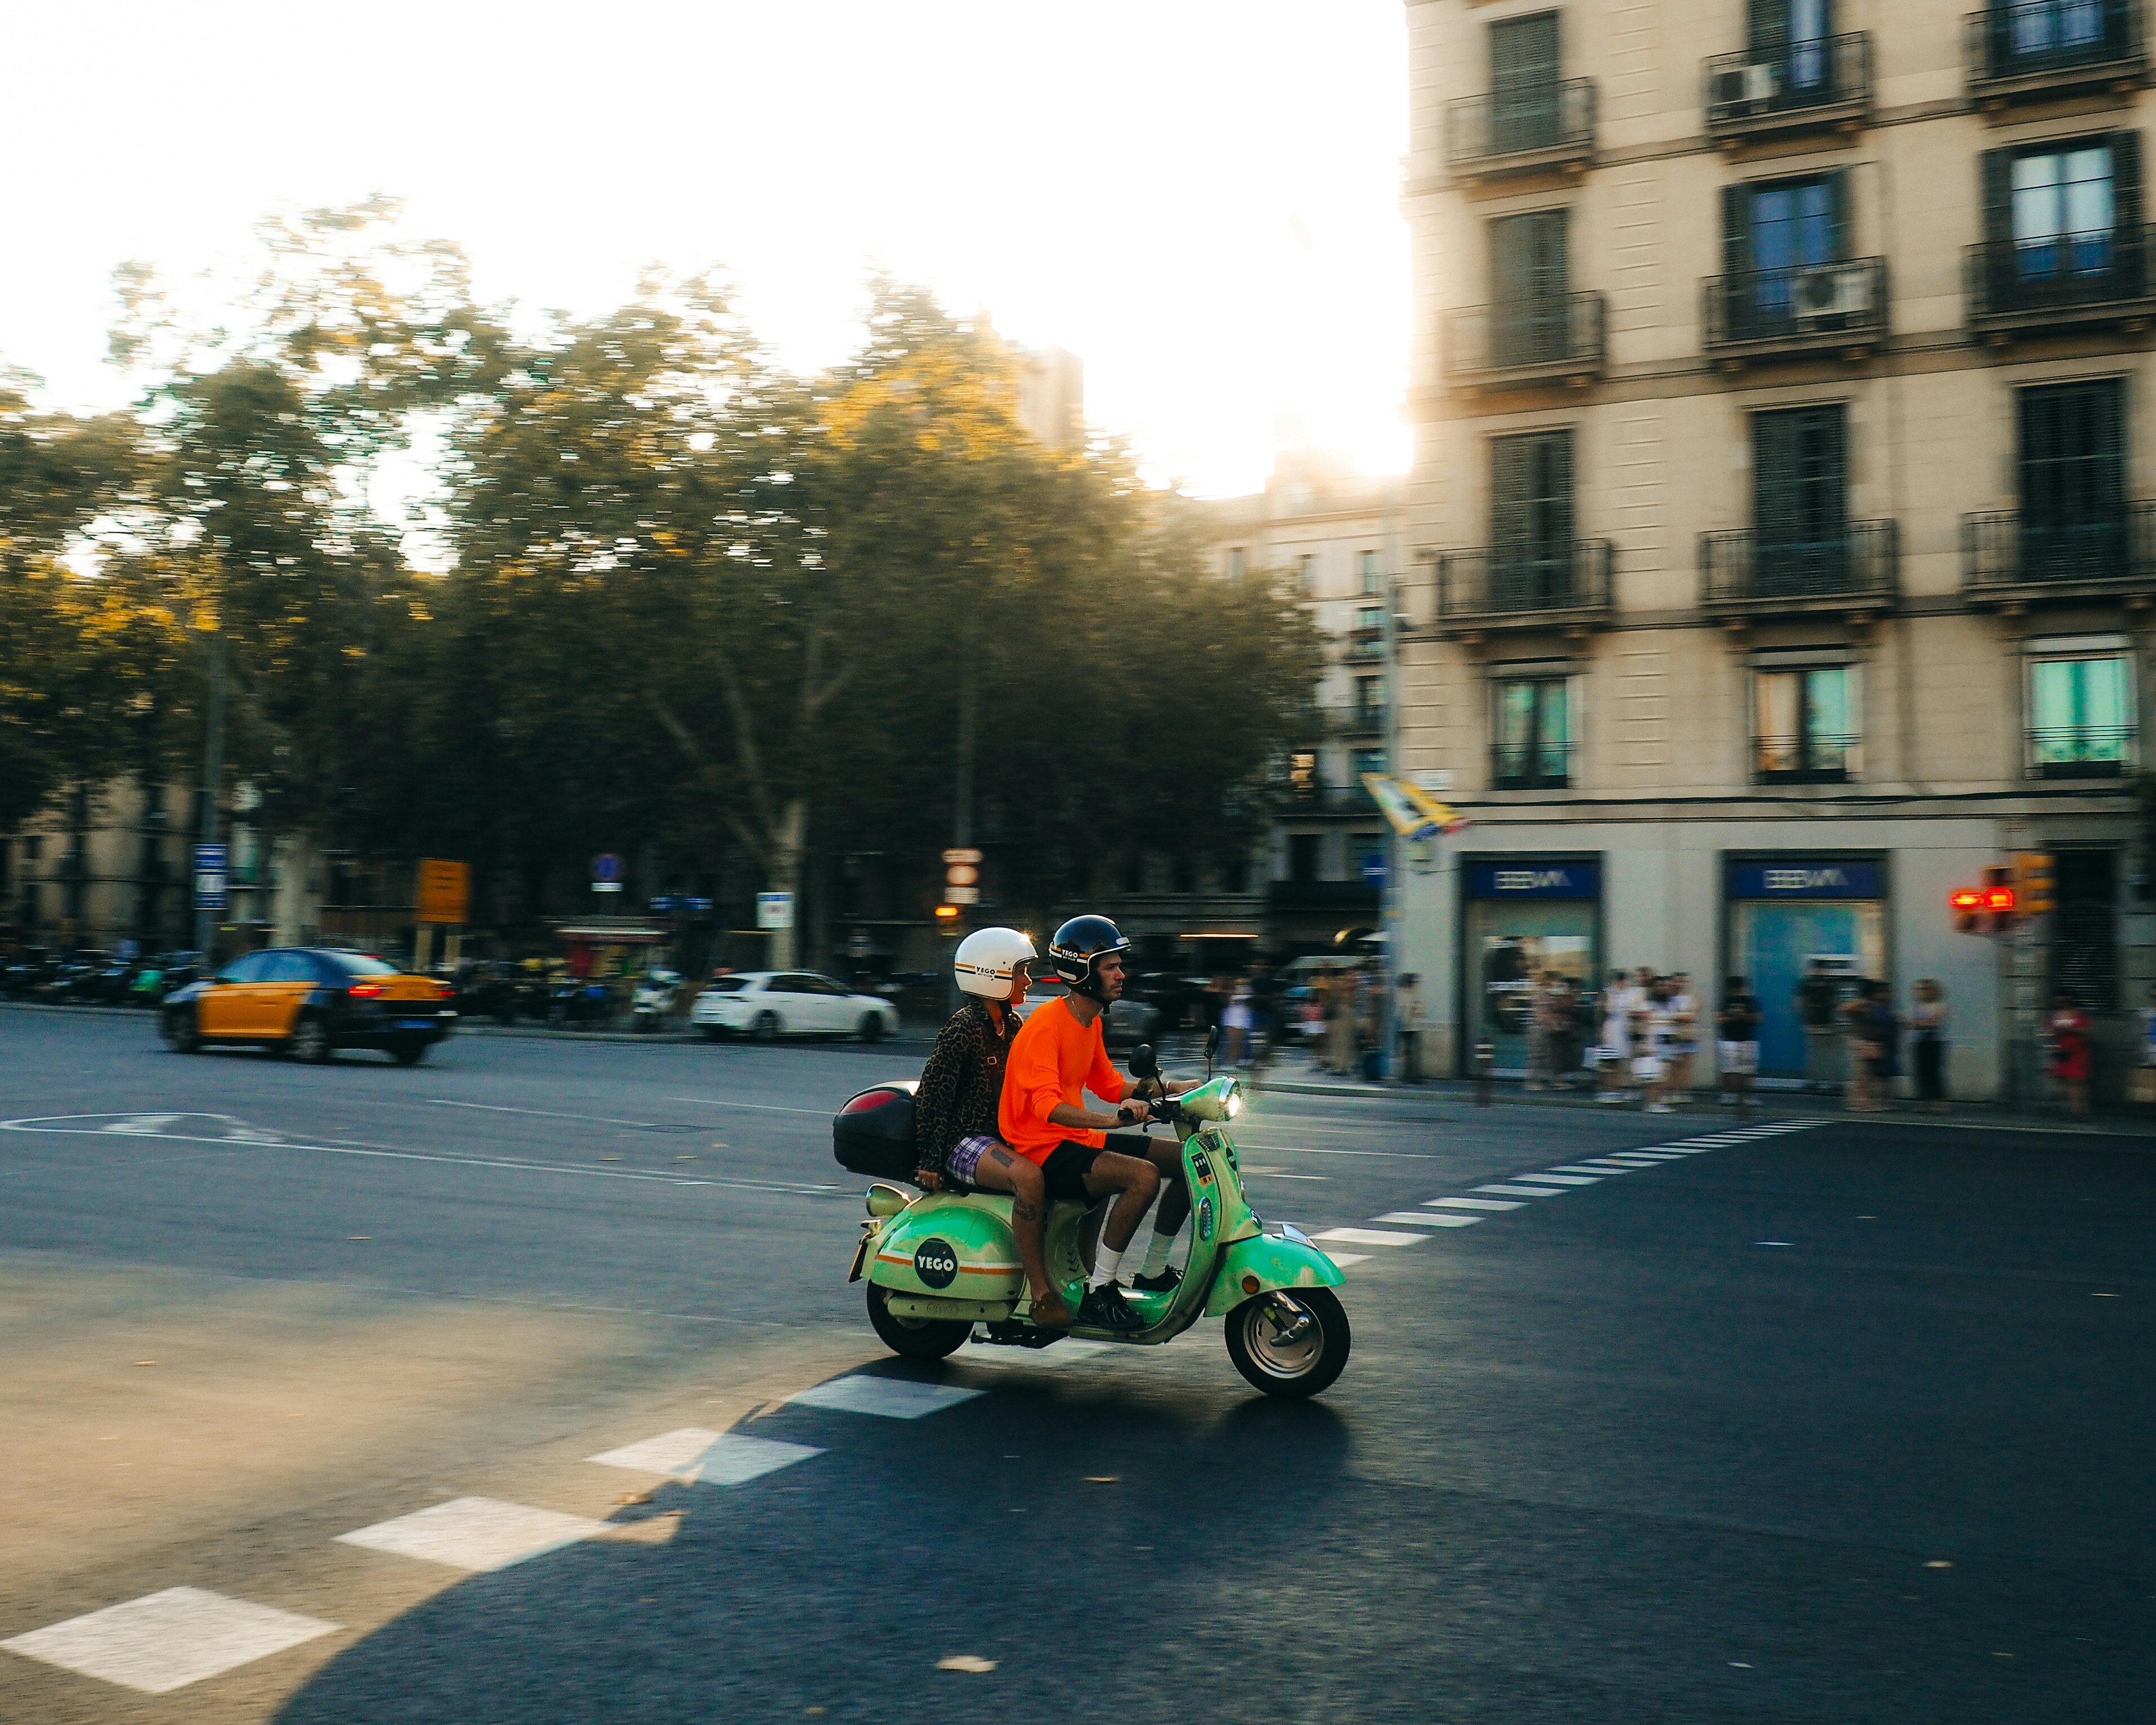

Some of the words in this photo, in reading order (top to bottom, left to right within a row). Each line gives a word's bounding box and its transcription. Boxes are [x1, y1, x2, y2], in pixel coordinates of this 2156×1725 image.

[1062, 949, 1078, 958] YEGO
[977, 966, 995, 975] YEGO
[918, 1255, 954, 1271] YEGO
